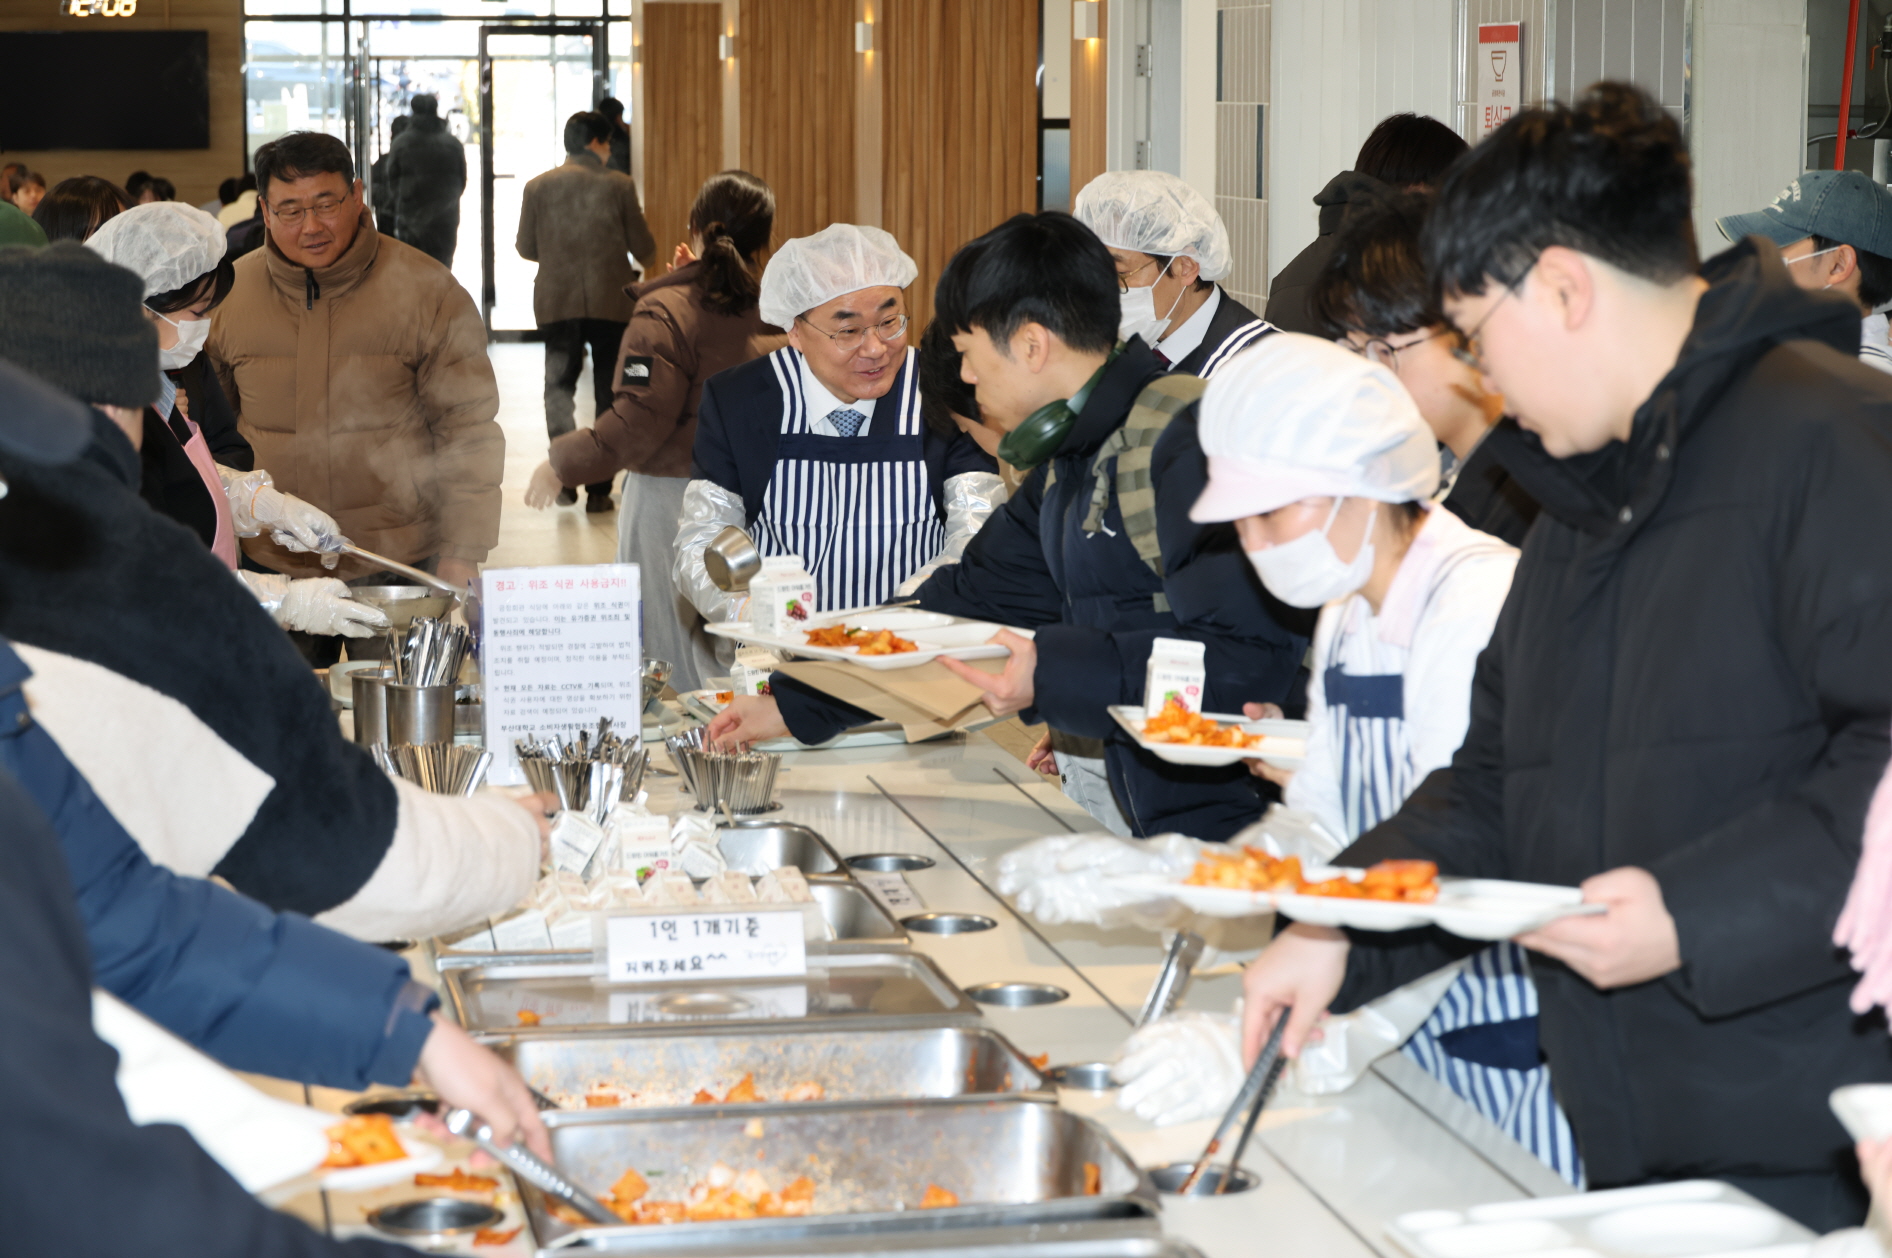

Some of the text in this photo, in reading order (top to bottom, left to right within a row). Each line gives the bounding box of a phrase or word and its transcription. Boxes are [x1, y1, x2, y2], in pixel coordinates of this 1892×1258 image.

[496, 581, 516, 591] 경고
[528, 580, 549, 590] 위조
[555, 579, 574, 589] 식권
[580, 578, 627, 589] 사용금지!!
[571, 614, 597, 622] 유가증권
[624, 613, 630, 621] 및
[504, 684, 516, 692] 현재
[501, 724, 535, 732] 부산대학교
[651, 921, 678, 941] 1인
